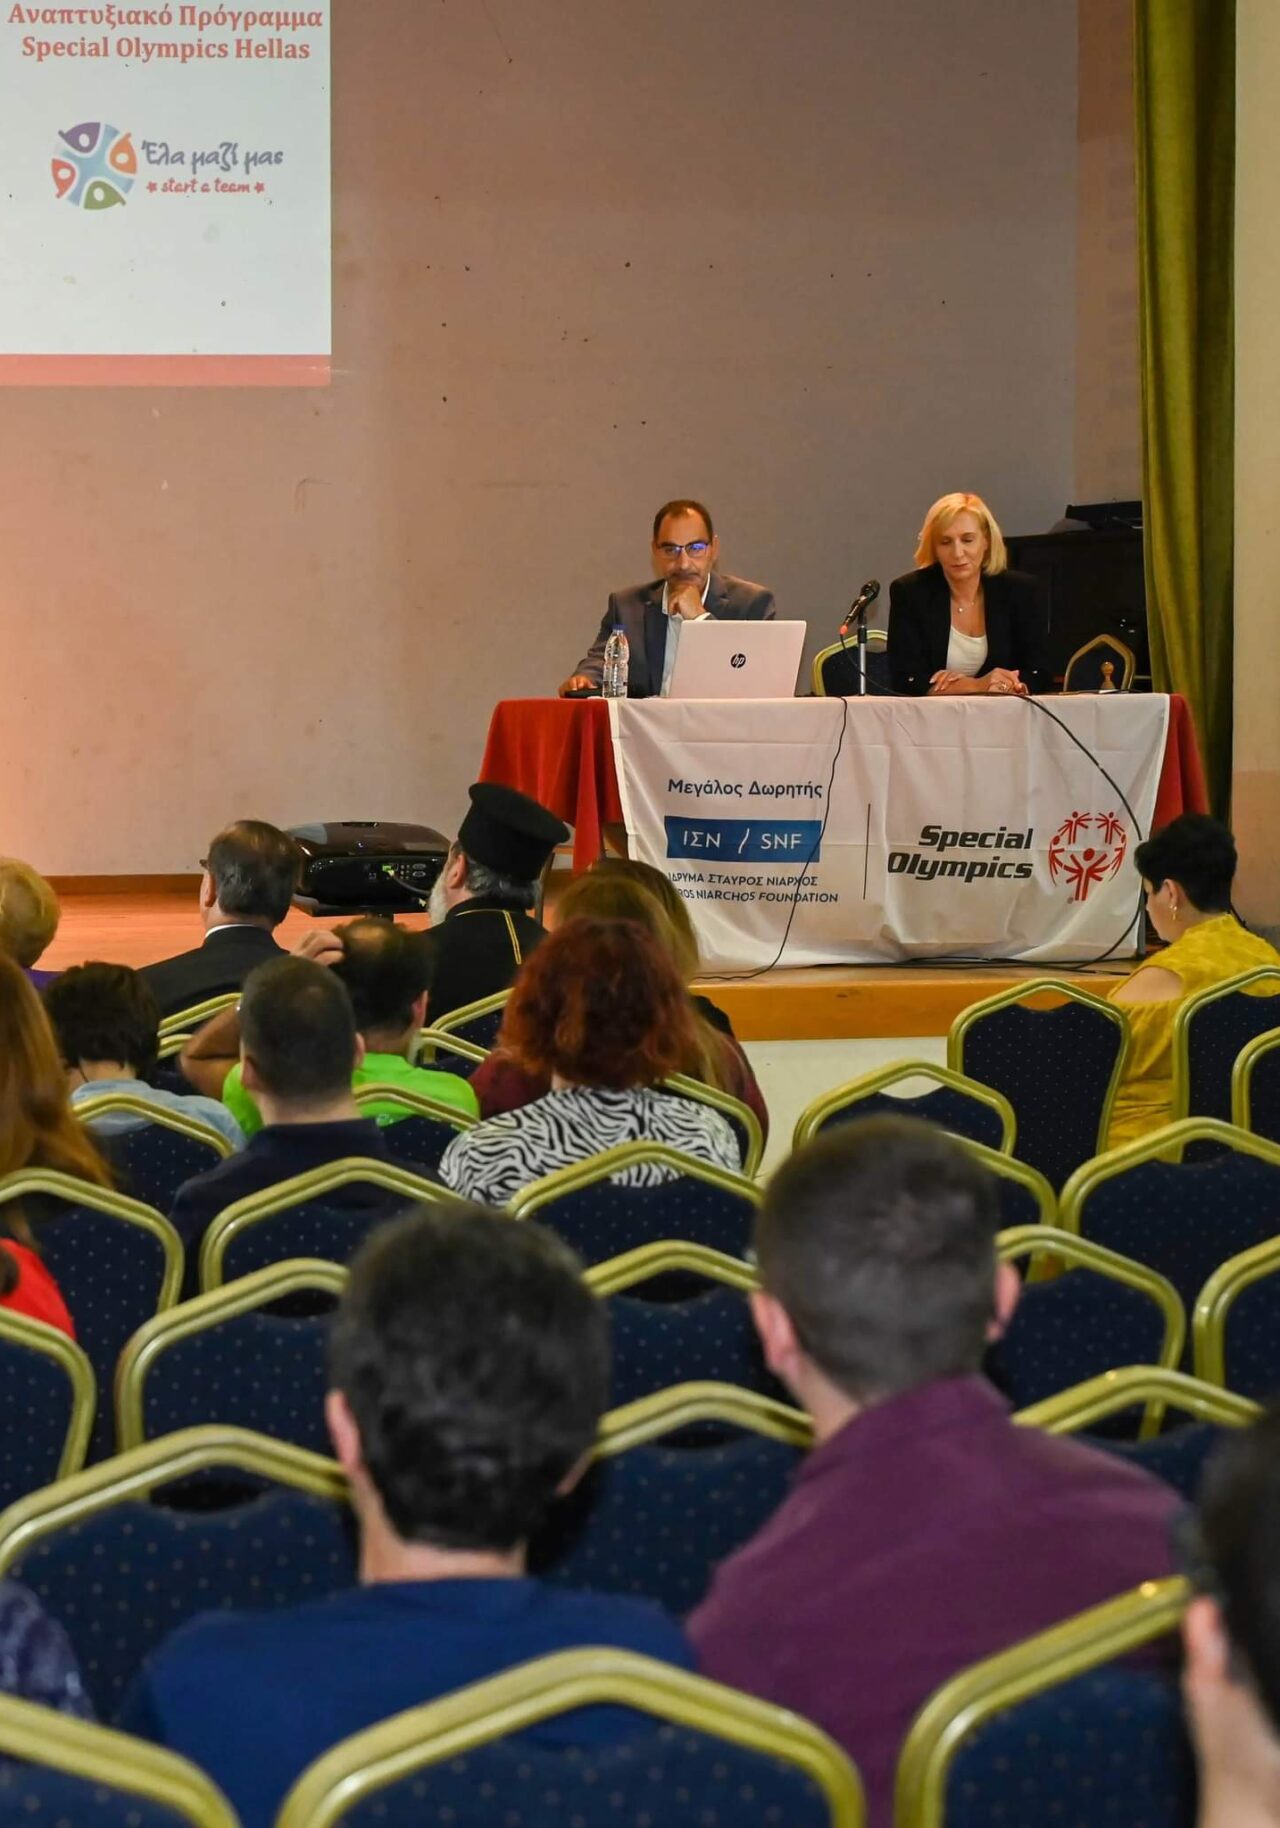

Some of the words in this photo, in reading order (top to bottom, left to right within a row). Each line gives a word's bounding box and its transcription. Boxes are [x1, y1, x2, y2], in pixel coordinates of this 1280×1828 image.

[8, 2, 172, 30] Αναπτυξιακό
[179, 3, 323, 31] Πρόγραμμα
[22, 36, 109, 62] Special
[116, 37, 229, 63] Olympics
[234, 38, 310, 60] Hellas
[191, 142, 239, 174] μαζί
[161, 177, 197, 194] start
[200, 184, 210, 194] a
[214, 178, 250, 194] team
[668, 778, 743, 797] Μεγάλος
[748, 780, 823, 799] Δωρητής
[683, 830, 720, 849] ΙΣΝ
[760, 832, 802, 850] SNF
[918, 825, 1034, 852] Special
[887, 852, 1034, 883] Olympics
[708, 873, 763, 887] ΣΤΑΥΡΟΣ
[766, 876, 818, 887] ΝΙΑΡΧΟΣ
[696, 889, 755, 902] NIARCHOS
[758, 890, 838, 903] FOUNDATION
